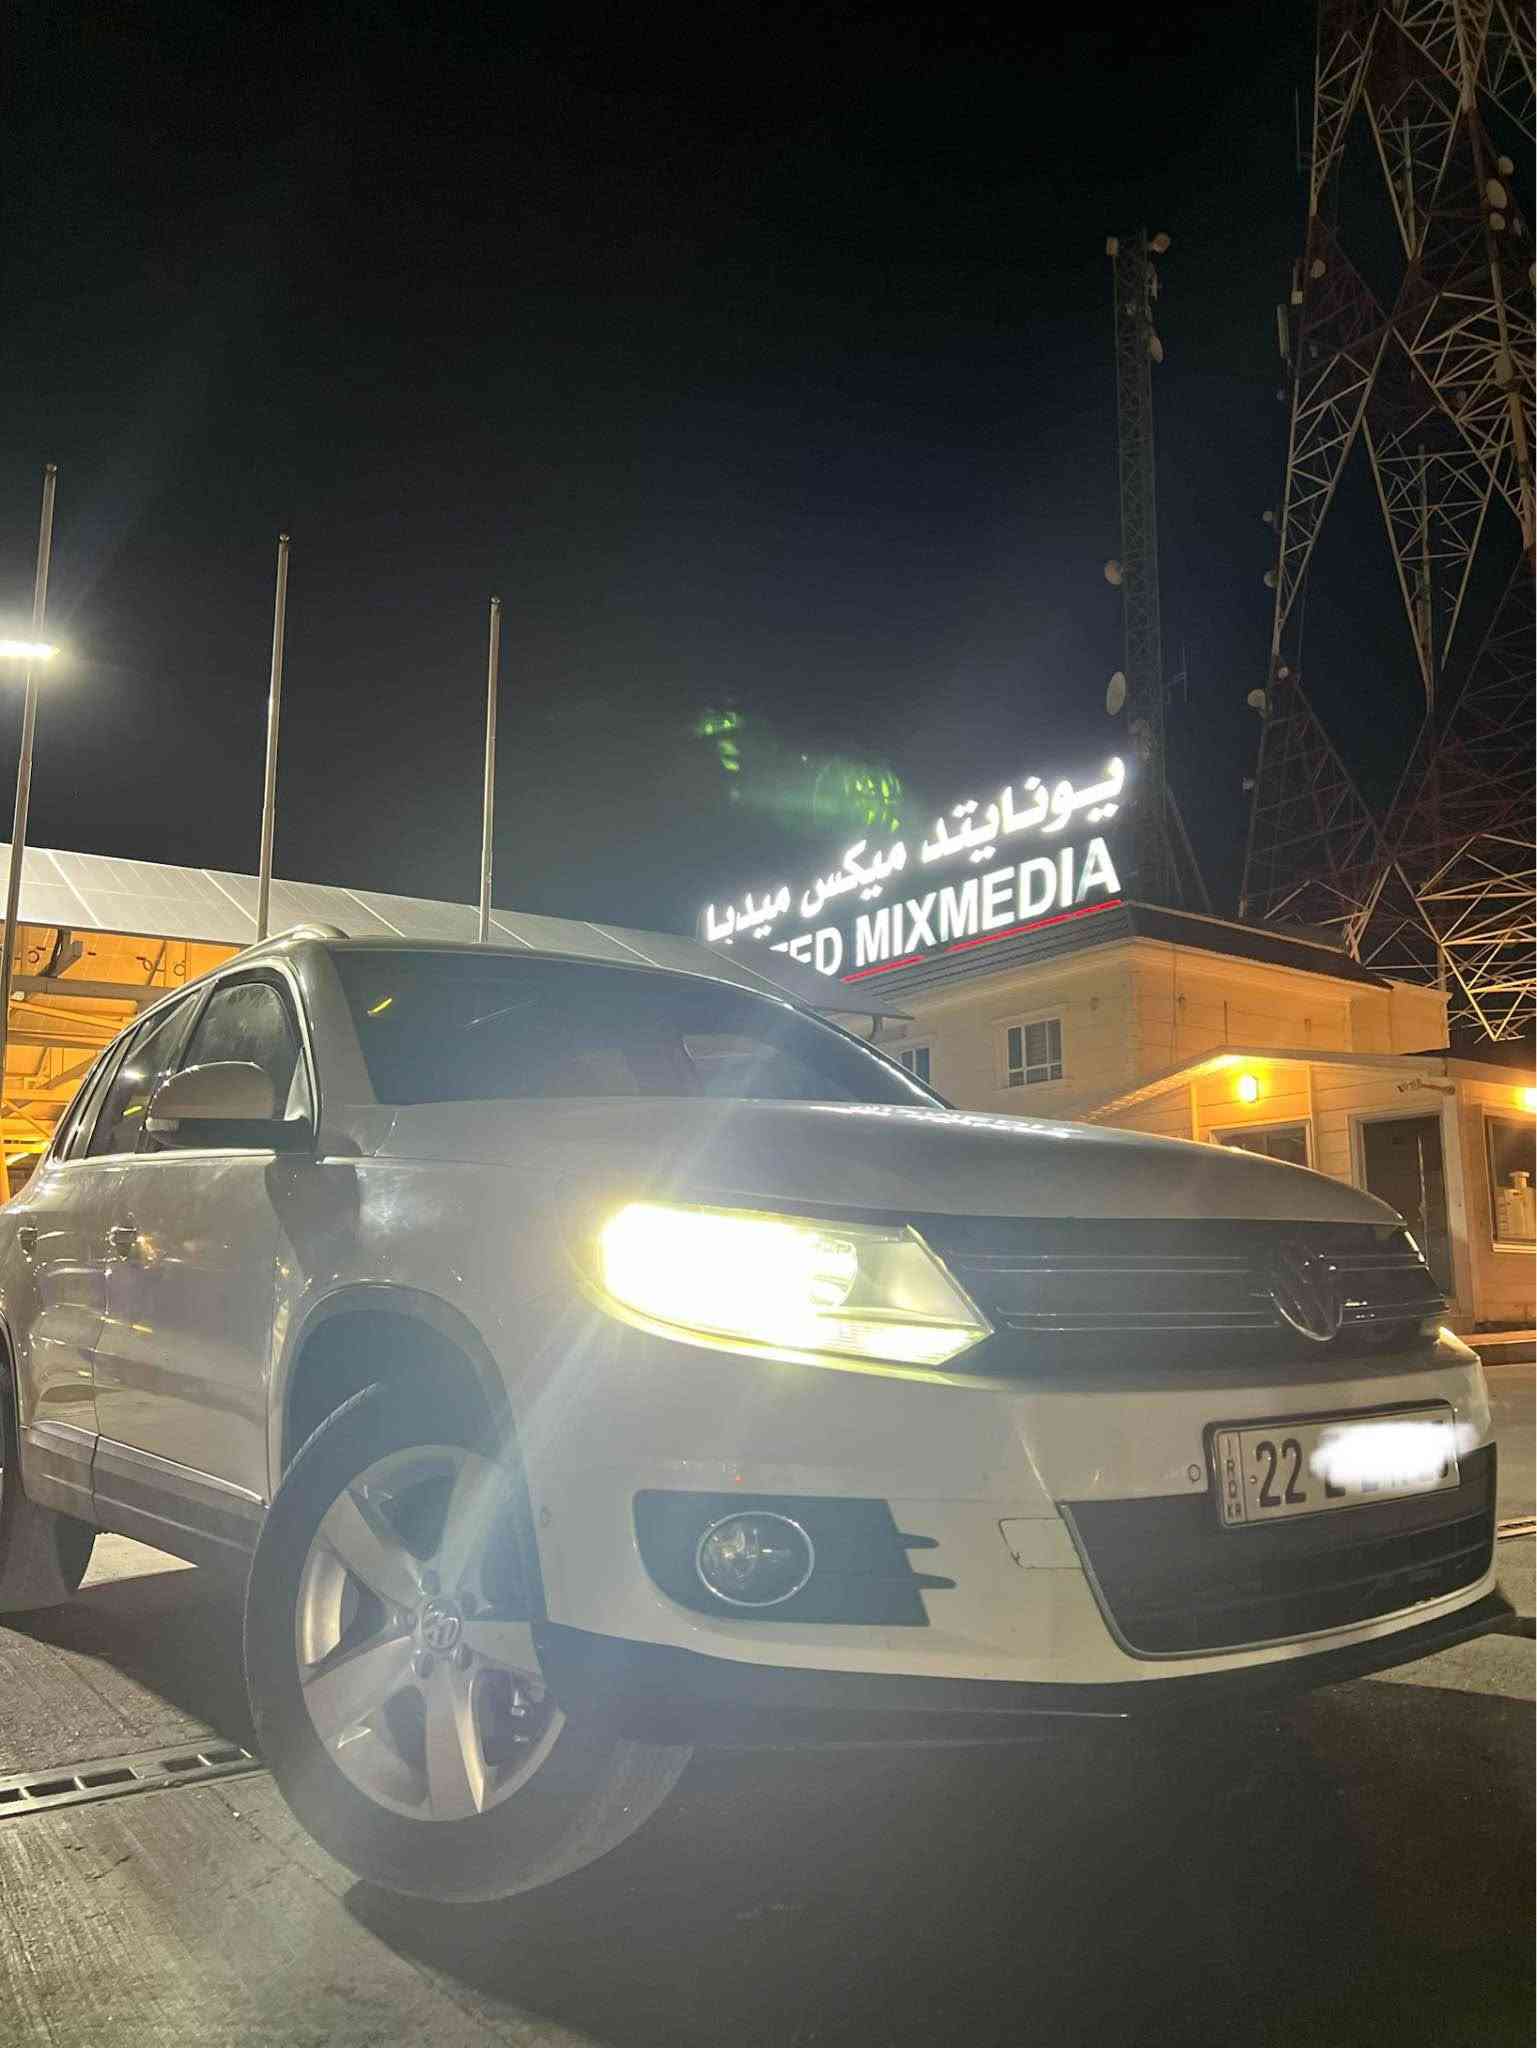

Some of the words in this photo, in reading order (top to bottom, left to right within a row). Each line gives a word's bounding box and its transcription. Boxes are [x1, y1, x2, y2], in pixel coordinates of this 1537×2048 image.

[919, 756, 1126, 864] يونايتد
[704, 885, 791, 945] ميديا
[799, 840, 908, 919] ميكس
[1255, 1438, 1307, 1508] 22
